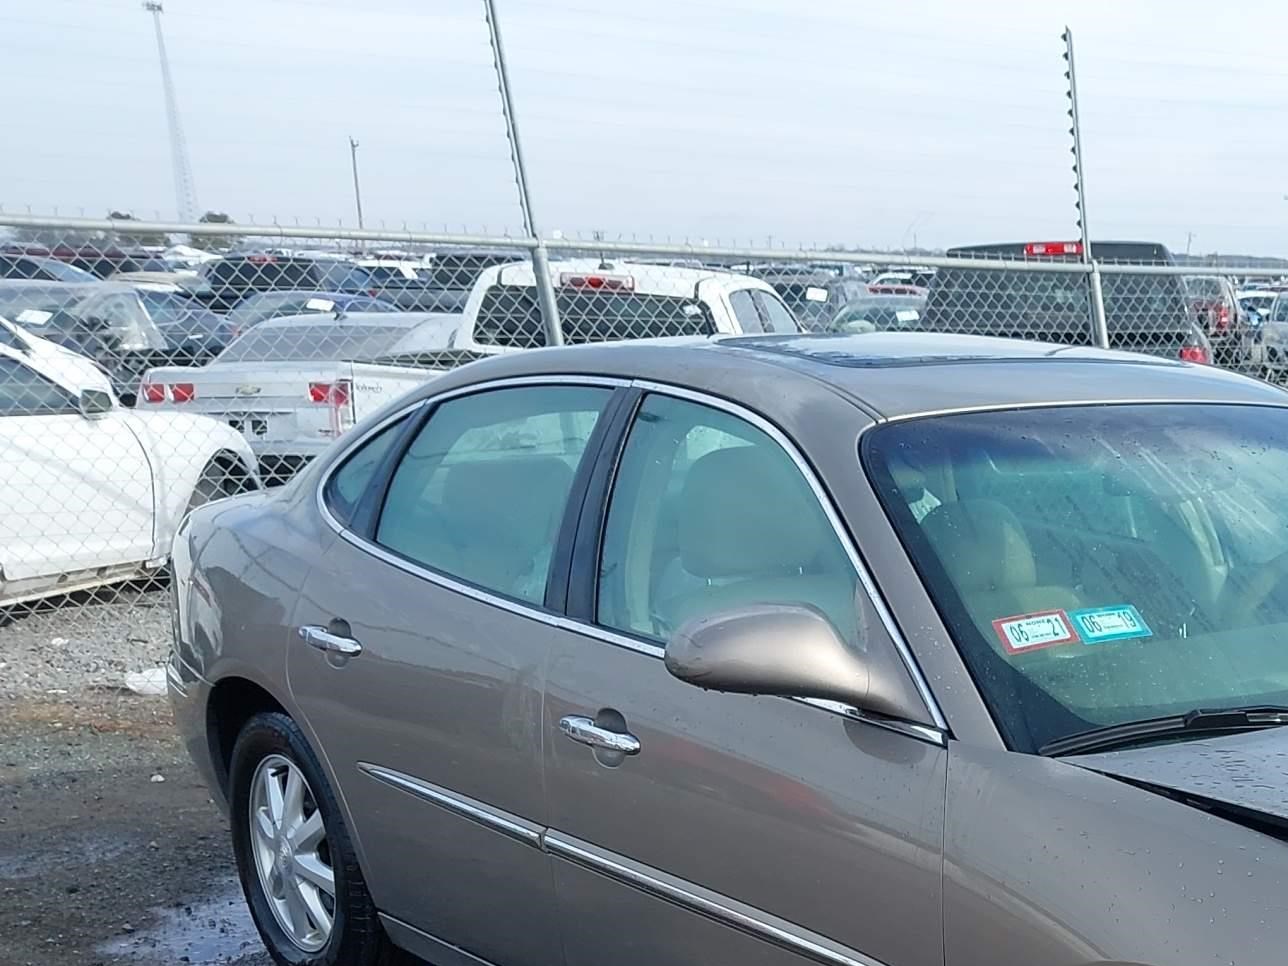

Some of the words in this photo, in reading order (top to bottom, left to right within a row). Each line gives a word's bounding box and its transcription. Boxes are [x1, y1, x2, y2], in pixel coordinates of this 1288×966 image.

[1010, 623, 1030, 642] 06
[1046, 617, 1067, 637] 21
[1081, 614, 1102, 633] 06
[1117, 610, 1137, 629] 19
